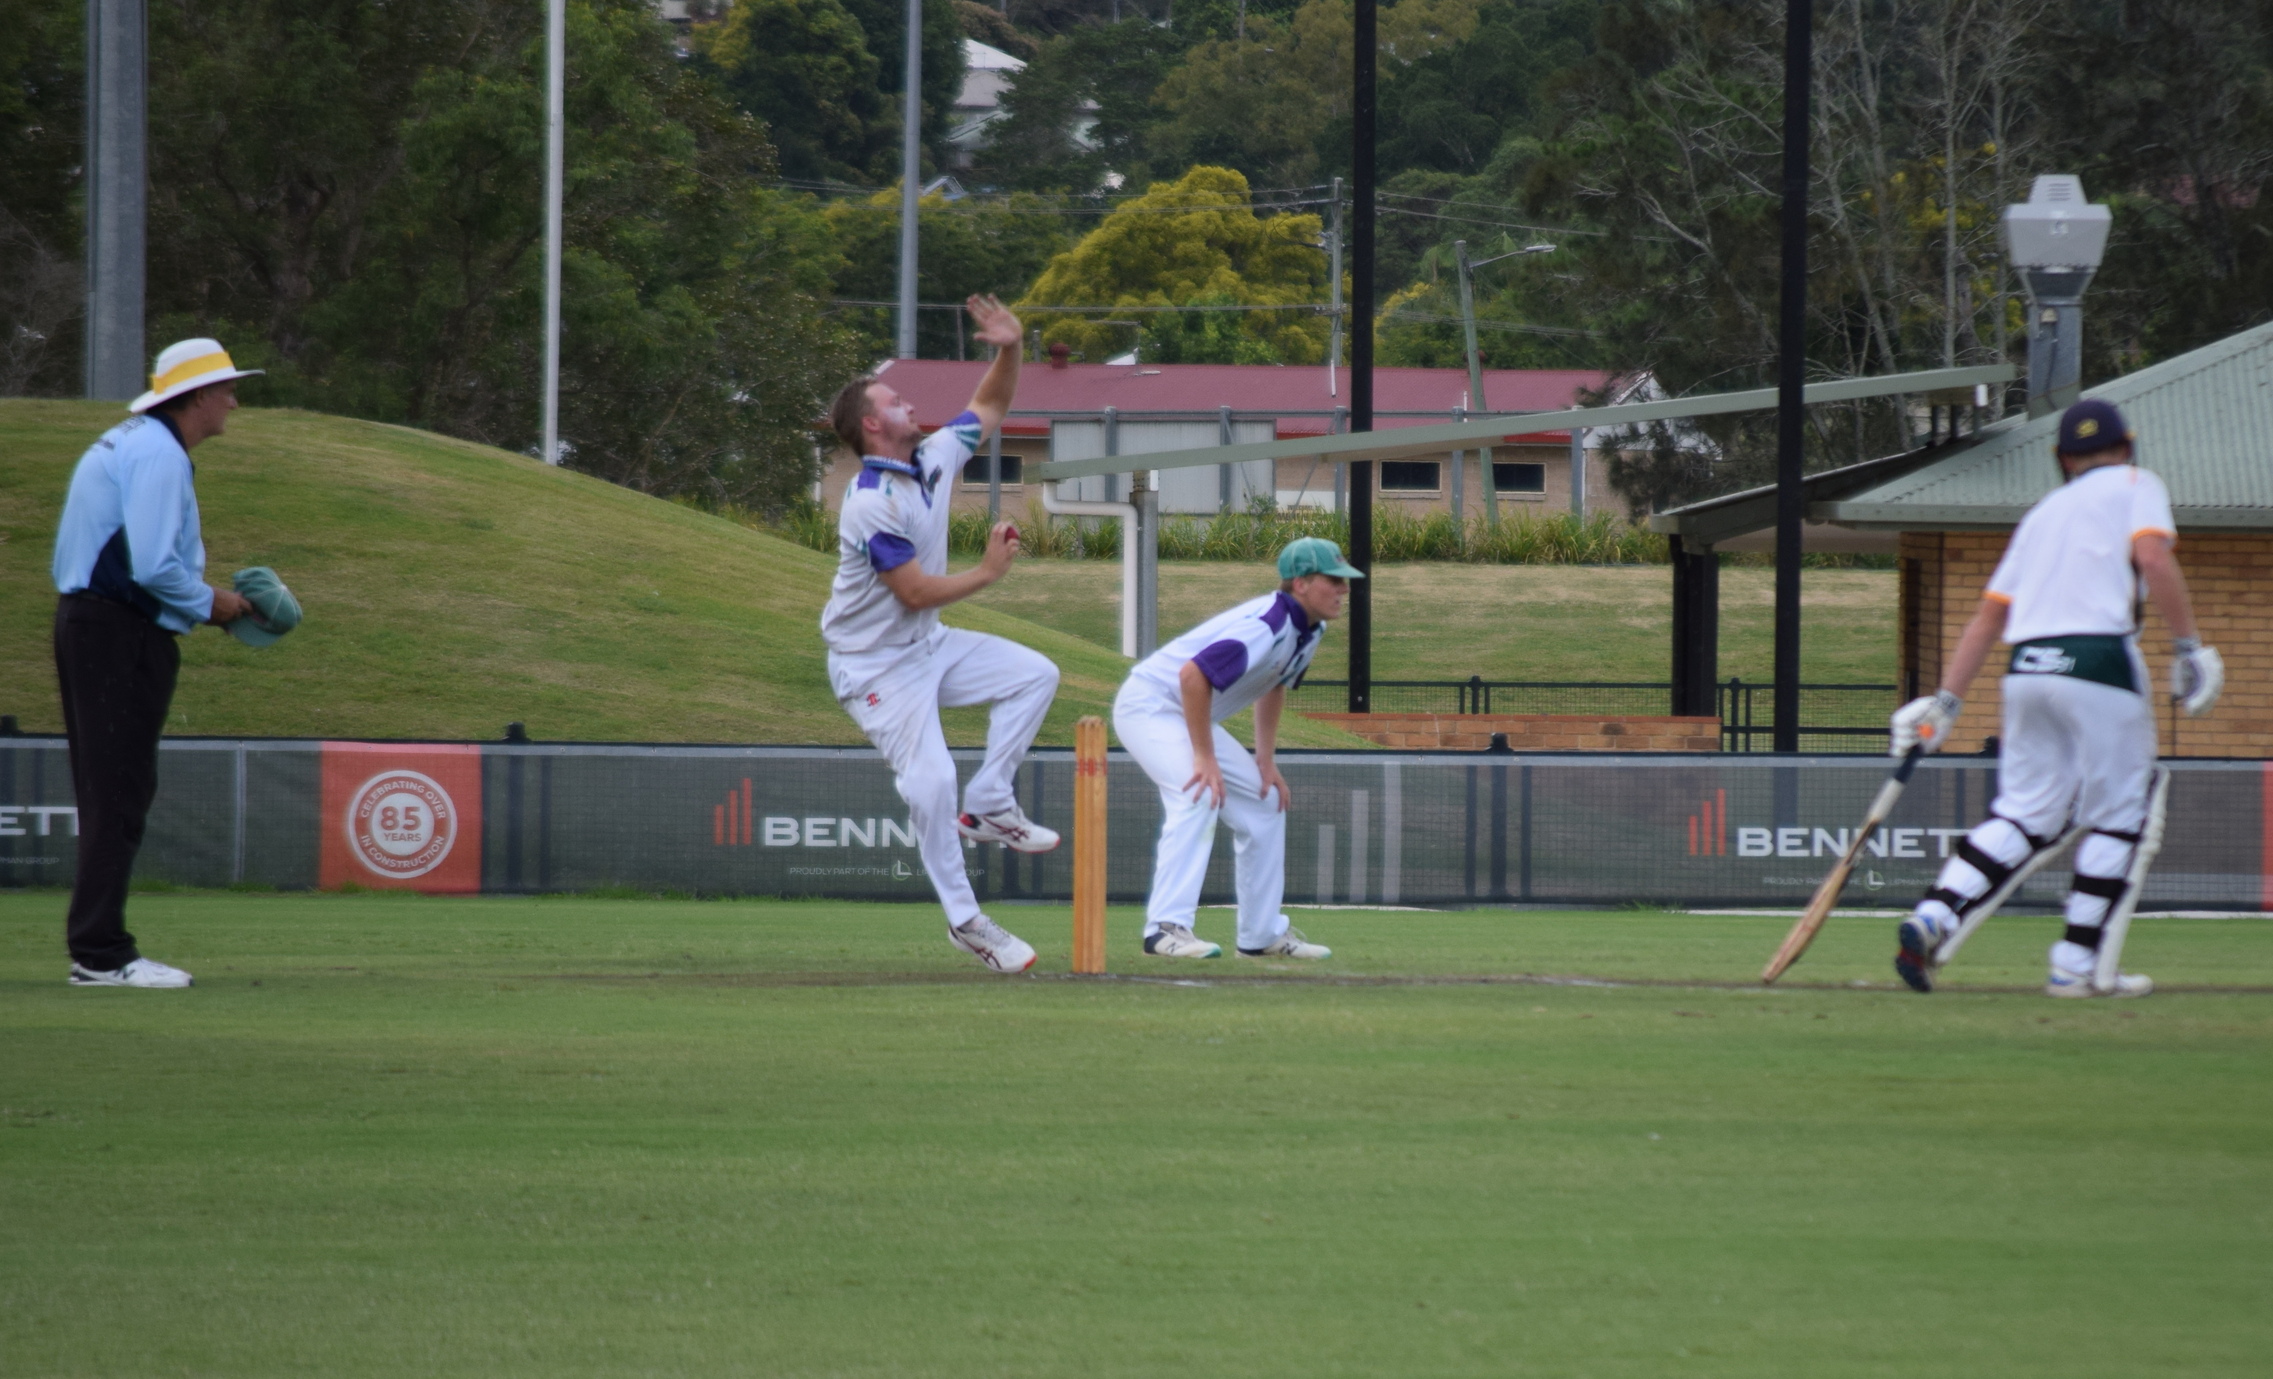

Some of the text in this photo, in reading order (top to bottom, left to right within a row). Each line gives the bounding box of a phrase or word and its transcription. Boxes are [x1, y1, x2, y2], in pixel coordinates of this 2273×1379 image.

[361, 780, 447, 819] CELEBRATING OVER
[380, 805, 422, 831] 85
[764, 816, 1008, 848] BENN
[361, 834, 445, 868] IN CONSTRUCTION
[384, 833, 422, 842] YEARS
[790, 867, 832, 875] PROUDLY
[833, 867, 856, 875] PART
[857, 867, 870, 875] OF
[872, 868, 889, 876] THE
